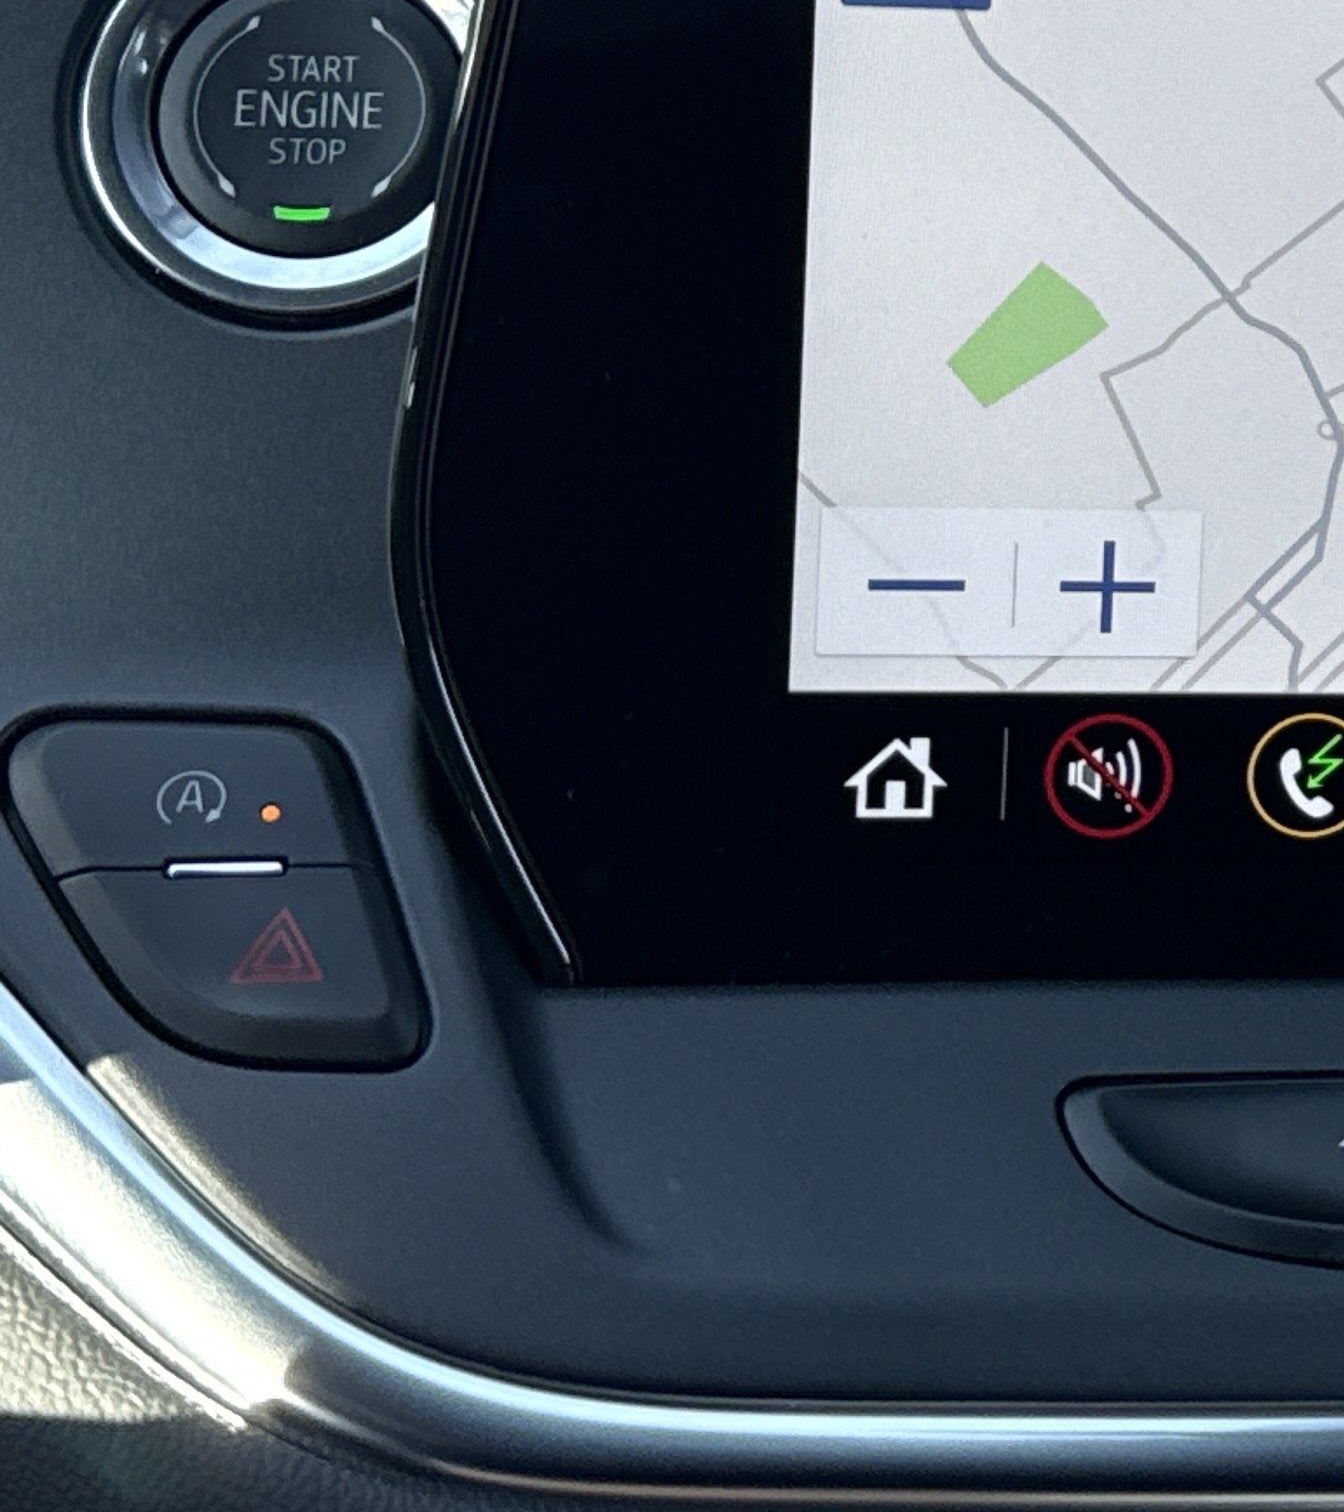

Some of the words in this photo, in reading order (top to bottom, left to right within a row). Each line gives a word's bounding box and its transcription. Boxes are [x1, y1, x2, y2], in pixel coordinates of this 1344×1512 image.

[267, 53, 360, 83] START
[233, 88, 385, 129] ENGINE
[268, 137, 347, 165] STOP
